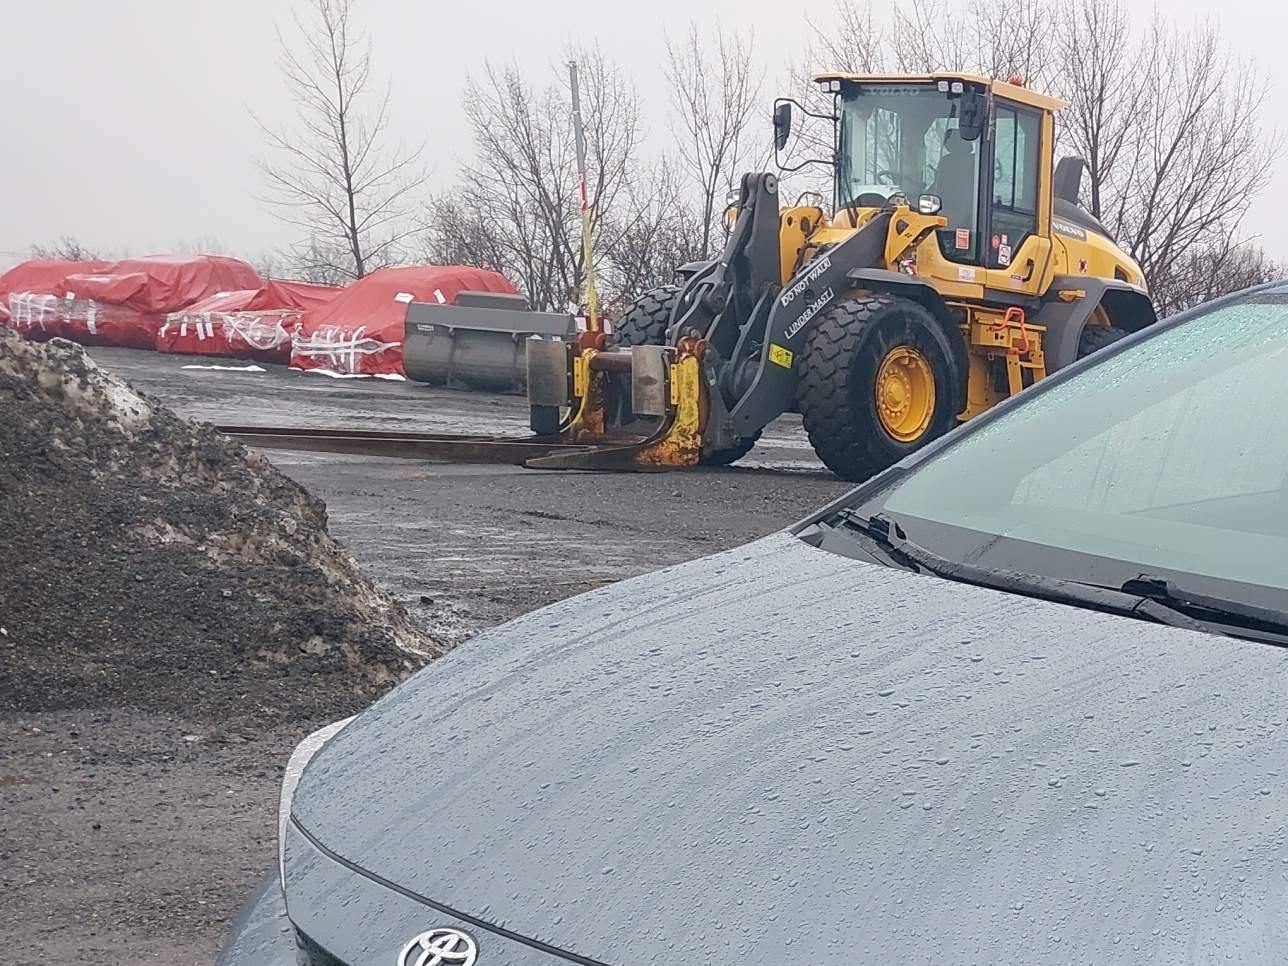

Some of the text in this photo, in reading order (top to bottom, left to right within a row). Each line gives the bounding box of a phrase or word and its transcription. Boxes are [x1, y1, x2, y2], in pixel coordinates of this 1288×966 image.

[781, 257, 831, 307] DO NOT WALK
[788, 290, 830, 334] UNDER MAST
